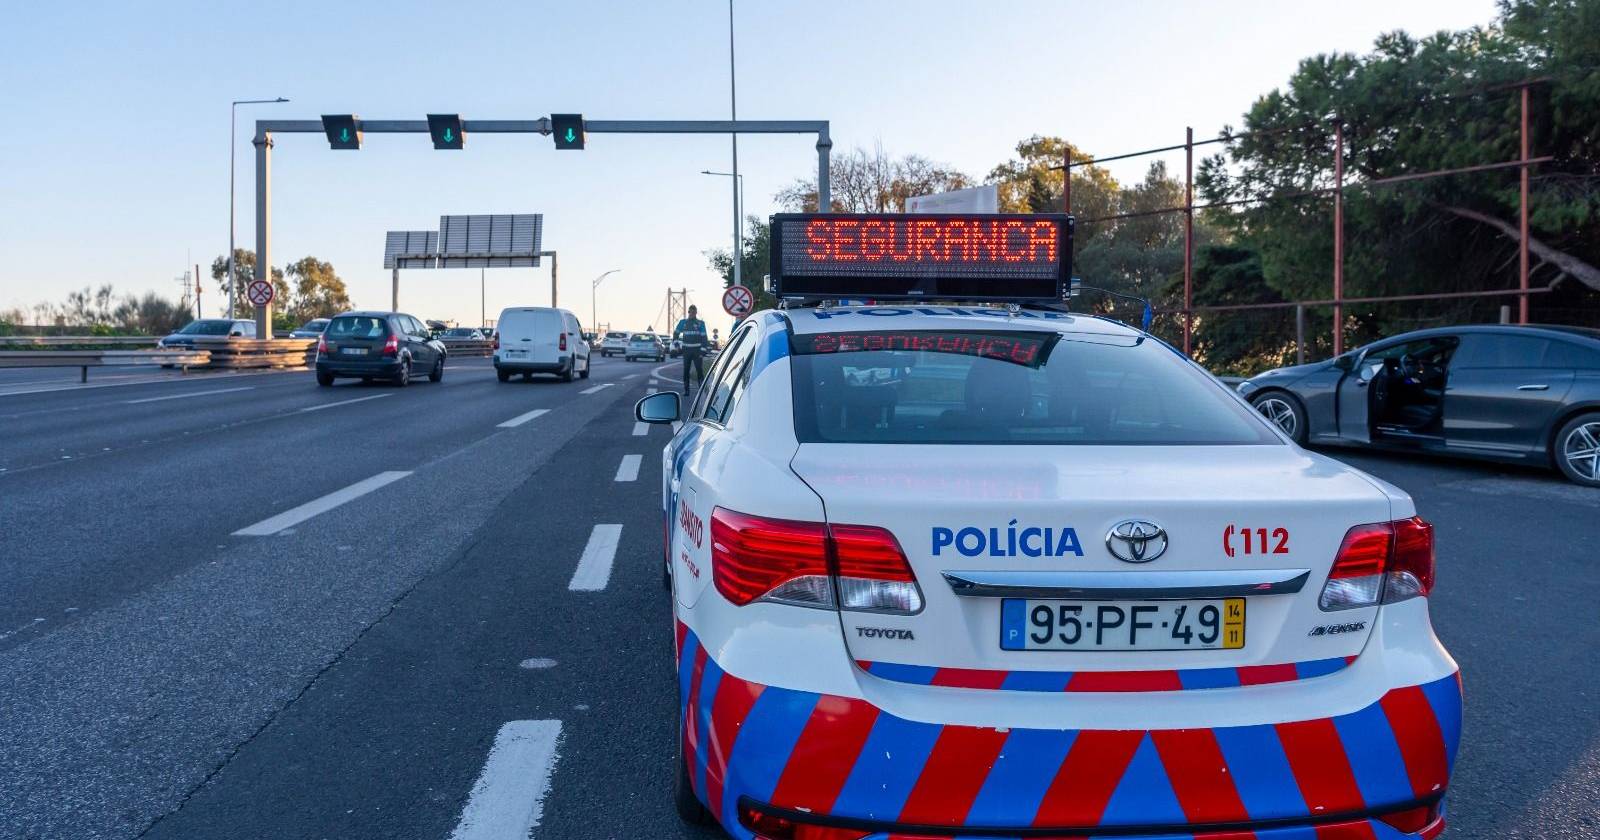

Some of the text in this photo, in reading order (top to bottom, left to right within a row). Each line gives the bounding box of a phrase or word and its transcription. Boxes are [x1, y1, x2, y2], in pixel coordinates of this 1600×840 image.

[806, 220, 1057, 262] SEGURANCA
[932, 519, 1084, 557] POLÍCIA
[1240, 527, 1289, 554] 112
[1228, 605, 1240, 618] 14
[855, 626, 915, 640] TOYOTA
[1009, 629, 1018, 641] P
[1229, 630, 1239, 643] 11
